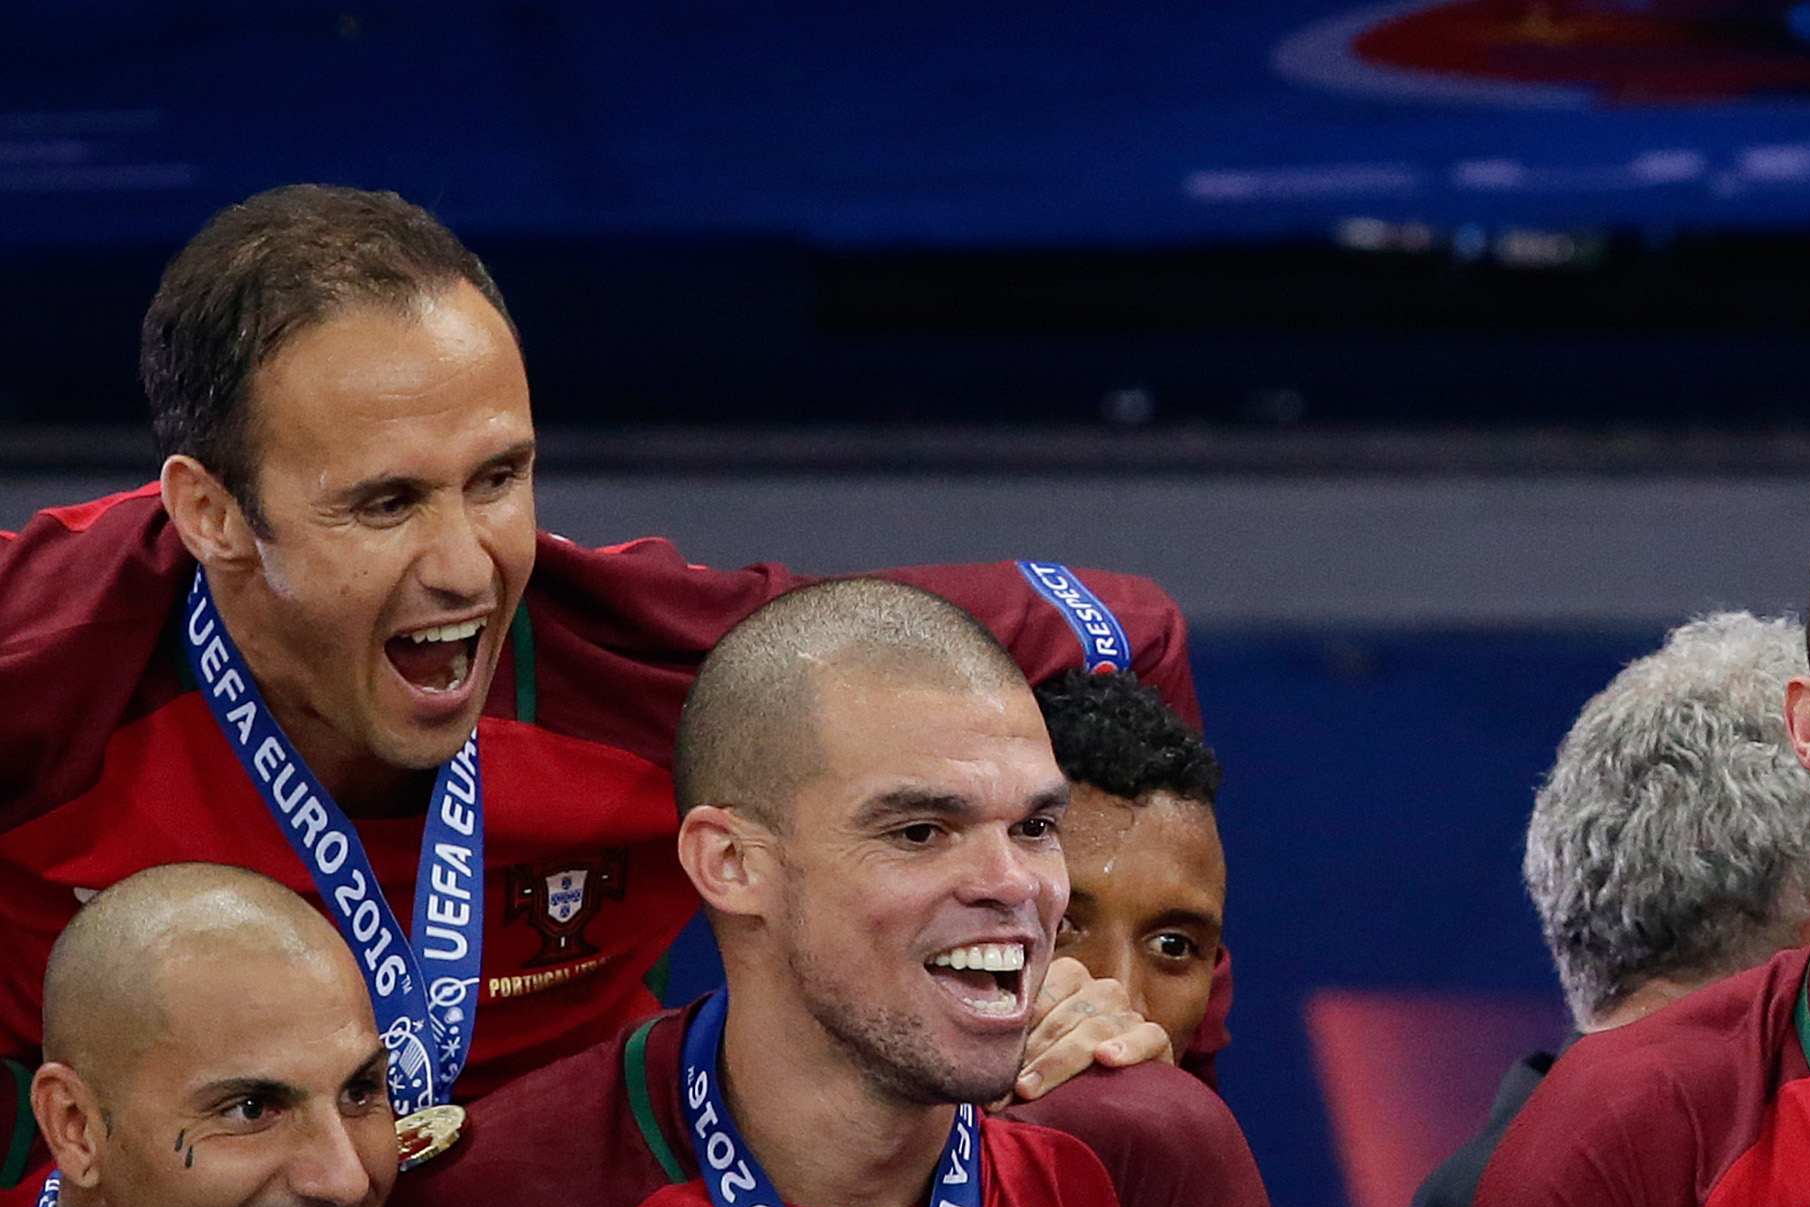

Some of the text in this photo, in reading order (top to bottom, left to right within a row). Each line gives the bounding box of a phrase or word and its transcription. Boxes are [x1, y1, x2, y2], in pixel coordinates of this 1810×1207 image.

[1030, 563, 1117, 656] RESPECT
[188, 598, 258, 745] UEFA
[254, 735, 349, 876] EURO
[424, 842, 474, 961] UEFA
[942, 1101, 975, 1186] EFA
